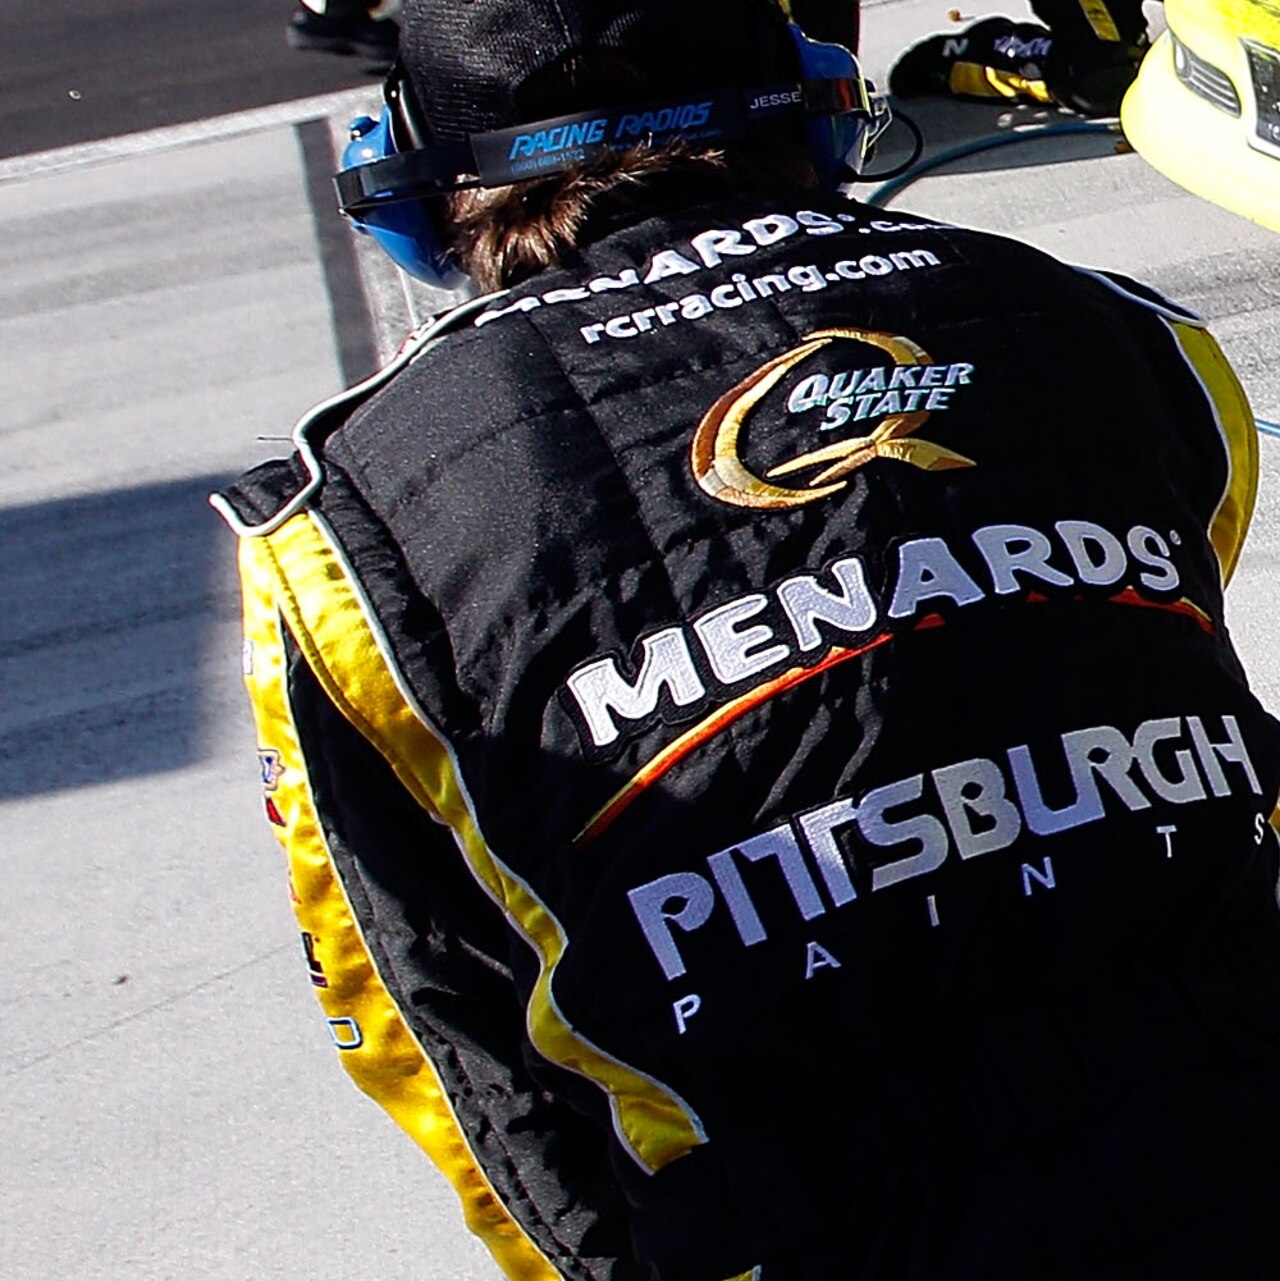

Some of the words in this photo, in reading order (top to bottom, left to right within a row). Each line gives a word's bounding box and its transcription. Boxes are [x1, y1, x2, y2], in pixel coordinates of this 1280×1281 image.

[750, 91, 803, 110] JESSE
[509, 118, 607, 160] RACING
[615, 101, 714, 139] RADIOS
[578, 246, 943, 345] rcrracing.com
[786, 362, 974, 412] QUAKER
[818, 384, 956, 432] STATE
[564, 520, 1175, 746] MENARDS
[626, 714, 1262, 980] PITTSBURGH
